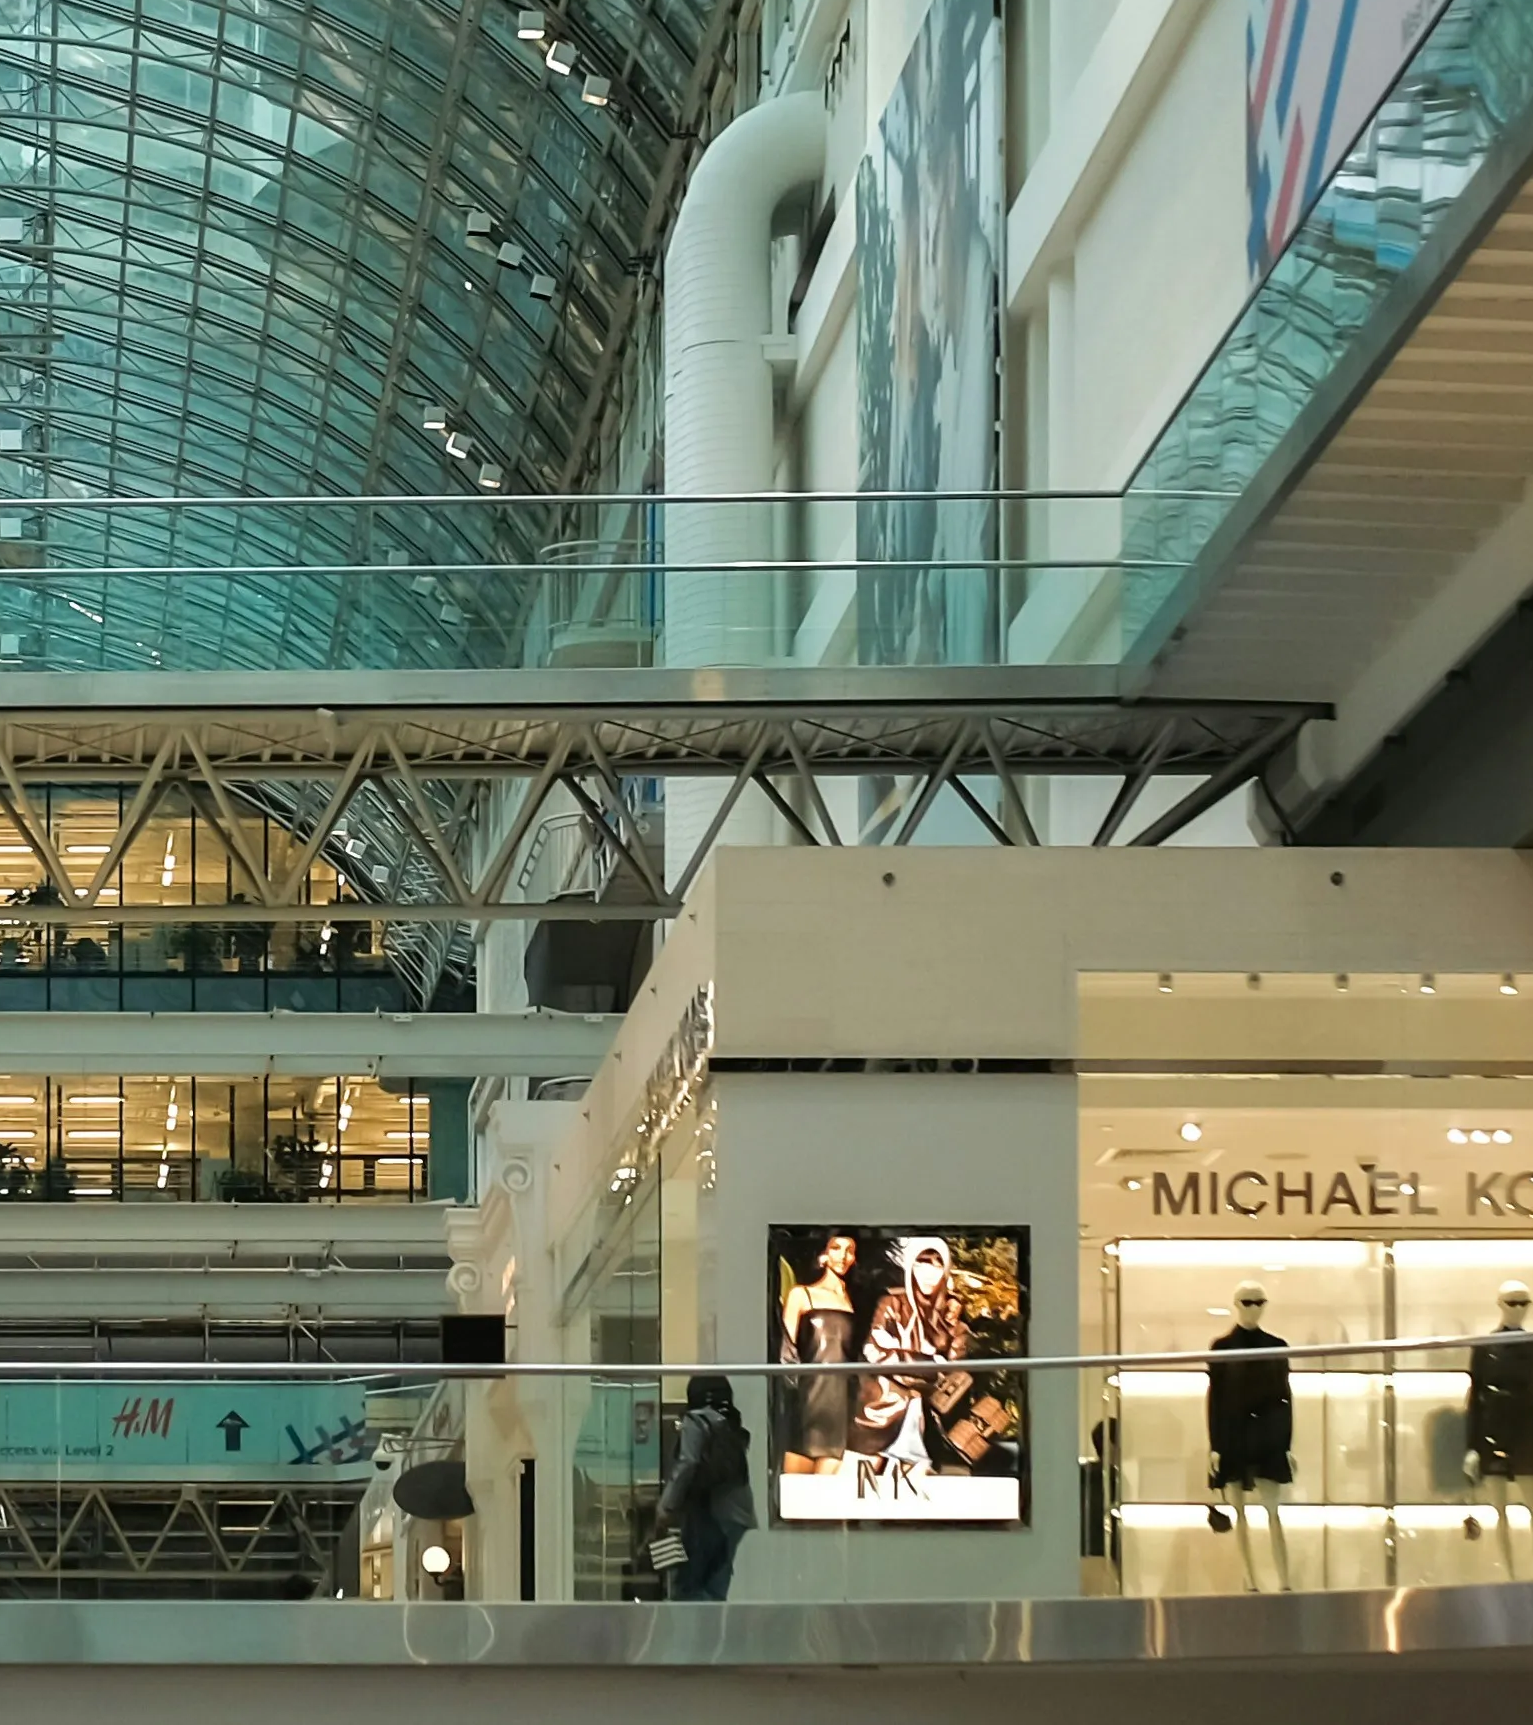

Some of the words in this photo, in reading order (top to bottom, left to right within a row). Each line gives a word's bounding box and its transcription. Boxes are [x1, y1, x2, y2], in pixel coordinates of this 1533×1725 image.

[1150, 1167, 1440, 1217] MICHAEL
[65, 1445, 101, 1457] Level
[106, 1445, 115, 1457] 2
